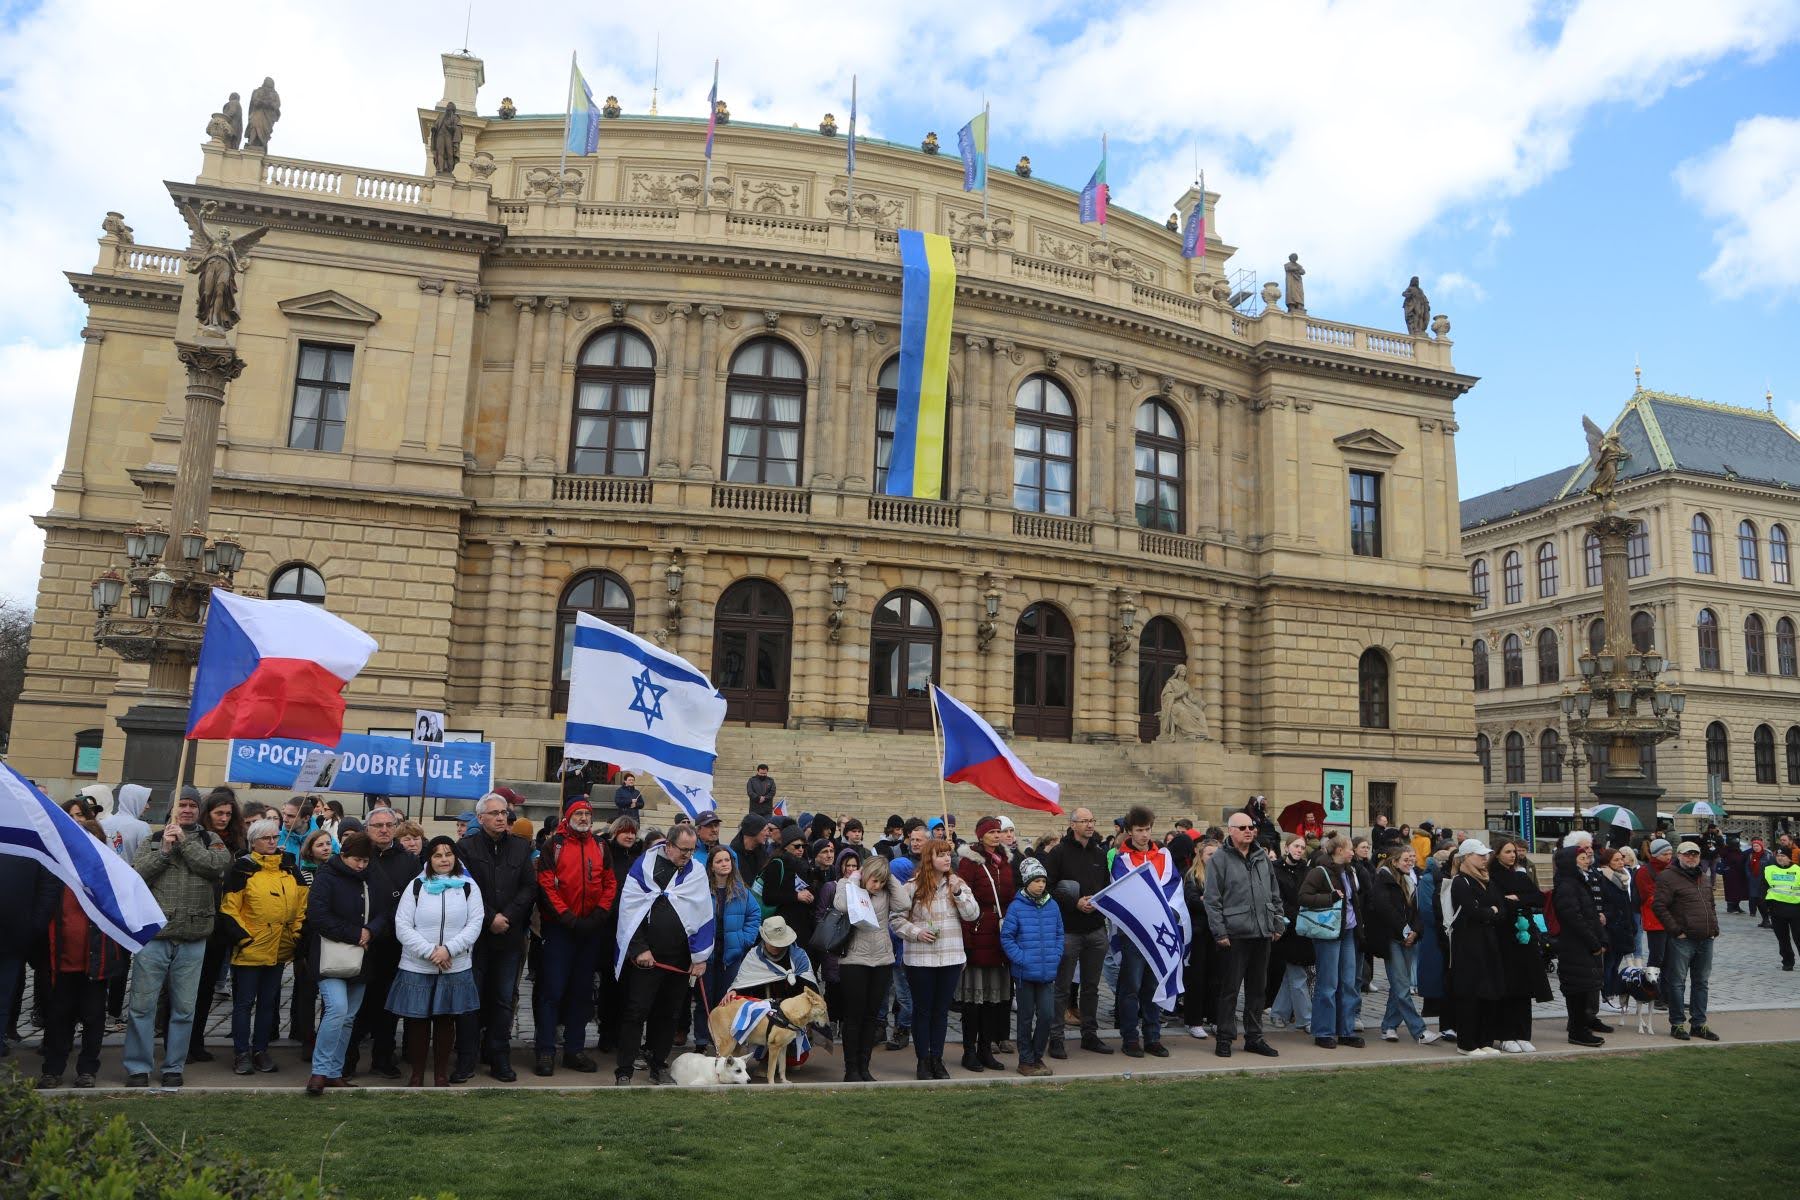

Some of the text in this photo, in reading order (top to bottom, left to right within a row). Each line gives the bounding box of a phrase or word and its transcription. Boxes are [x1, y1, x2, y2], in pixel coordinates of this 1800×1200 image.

[257, 743, 336, 767] POCH
[341, 751, 411, 777] DOBRÉ
[416, 754, 463, 779] VŮLE
